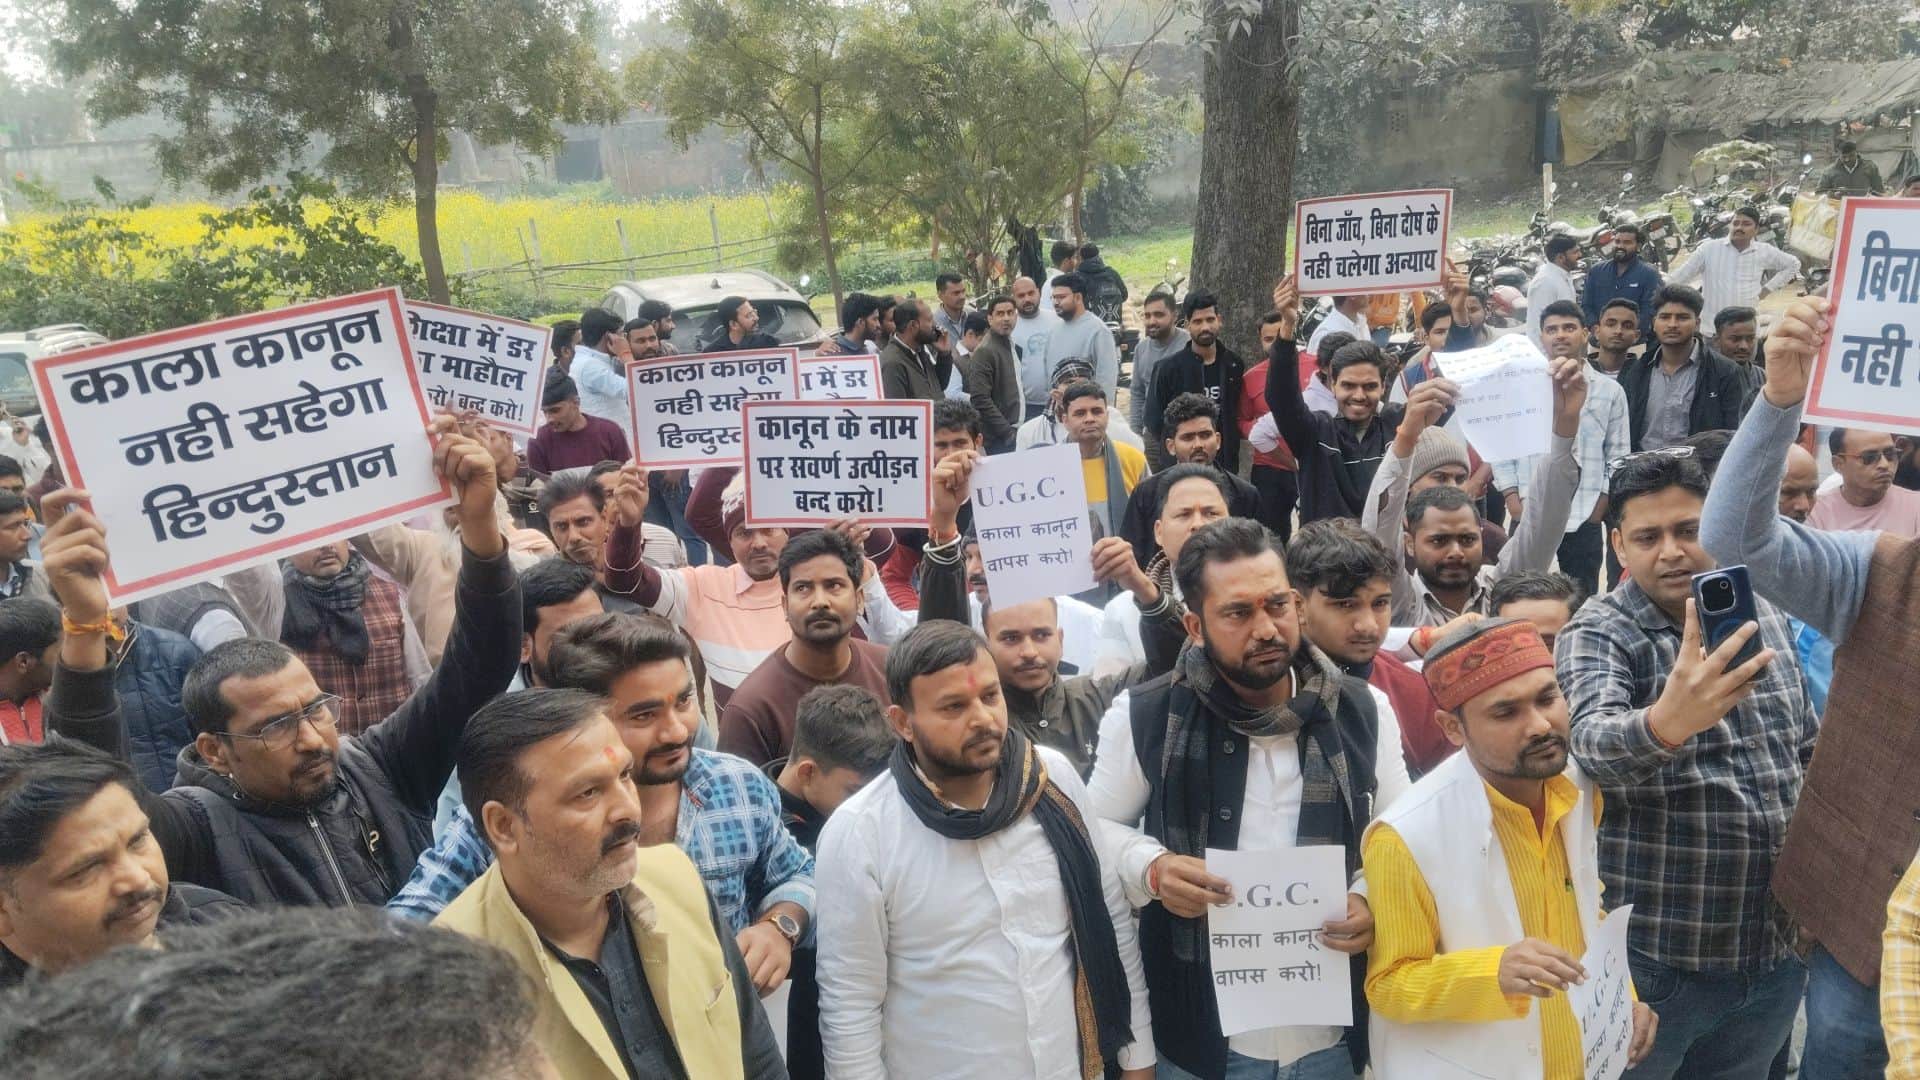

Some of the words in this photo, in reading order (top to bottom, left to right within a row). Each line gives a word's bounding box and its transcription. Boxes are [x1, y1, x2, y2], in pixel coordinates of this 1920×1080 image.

[1305, 213, 1333, 245] बिना
[1370, 207, 1398, 240] बिना
[1401, 205, 1424, 237] दोष
[1426, 203, 1440, 235] के
[1303, 251, 1332, 280] नही
[1335, 249, 1381, 278] चलेगा
[1385, 250, 1438, 275] अन्याय
[62, 343, 220, 405] काला
[225, 309, 383, 372] कानून
[476, 323, 504, 354] में
[506, 335, 537, 361] डर
[1840, 323, 1912, 388] नही
[441, 355, 527, 391] माहौल
[637, 362, 704, 385] काला
[711, 357, 786, 384] कानून
[816, 365, 838, 389] में
[841, 370, 868, 388] डर
[458, 393, 487, 413] बन्द
[490, 398, 524, 421] करो!
[654, 388, 704, 416] नही
[119, 399, 234, 466] नही
[239, 378, 388, 434] सहेगा
[756, 415, 830, 449] कानून
[835, 409, 862, 440] के
[867, 416, 919, 441] नाम
[757, 456, 785, 480] पर
[788, 451, 841, 480] सवर्ण
[846, 451, 919, 485] उत्पीड़न
[141, 443, 398, 543] हिन्दुस्तान
[793, 490, 831, 513] बन्द
[835, 485, 884, 514] करो!
[976, 476, 1065, 508] U.G.C.
[980, 525, 1022, 542] काला
[1031, 516, 1079, 540] कानून
[986, 553, 1030, 573] वापस
[1213, 881, 1320, 909] .G.C.
[1211, 933, 1263, 949] काला
[1215, 968, 1267, 987] वापस
[1278, 960, 1322, 983] करो!
